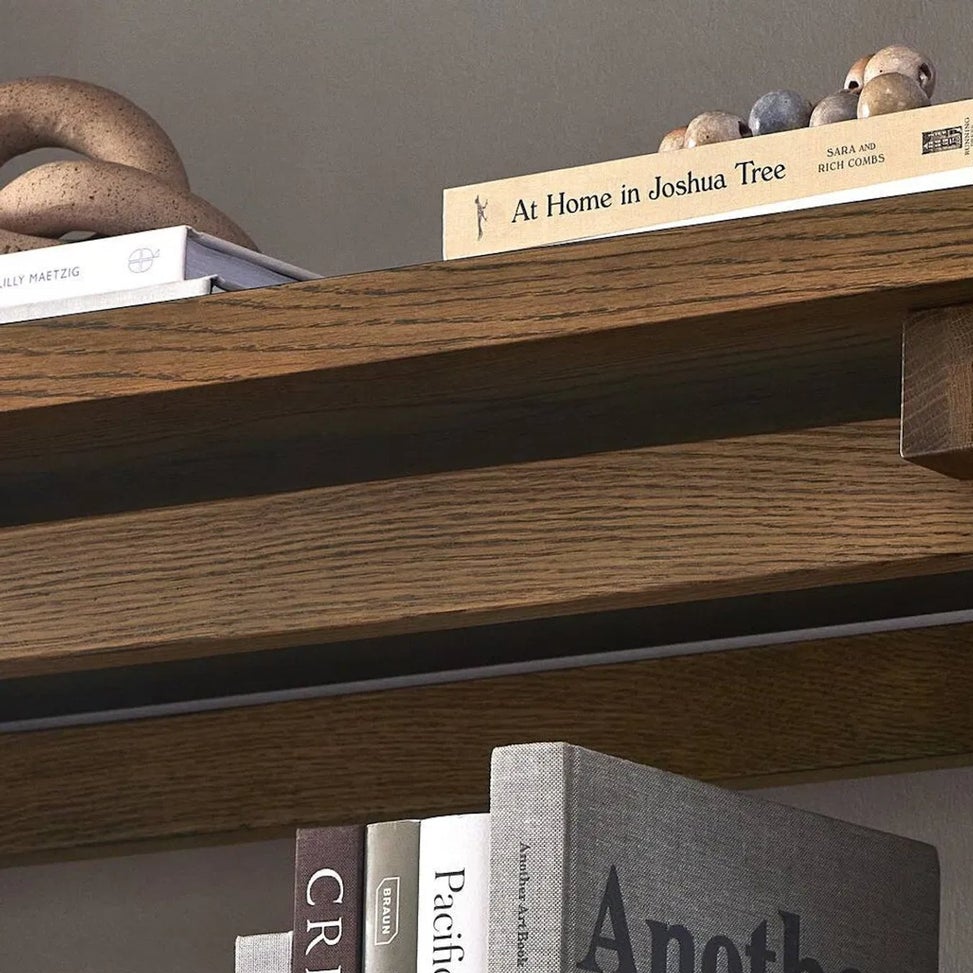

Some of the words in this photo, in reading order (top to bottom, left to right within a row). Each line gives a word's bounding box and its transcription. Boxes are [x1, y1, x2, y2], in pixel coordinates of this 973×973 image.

[818, 160, 844, 173] RICH
[847, 153, 886, 168] COMBS
[826, 144, 856, 158] SARA
[858, 142, 877, 153] AND
[511, 199, 538, 223] At
[547, 192, 612, 217] Home
[620, 185, 641, 205] in
[649, 172, 727, 201] Joshua
[735, 161, 787, 185] Tree
[29, 266, 81, 284] MAETZIG
[518, 842, 531, 902] Another
[381, 887, 392, 935] BRAUN
